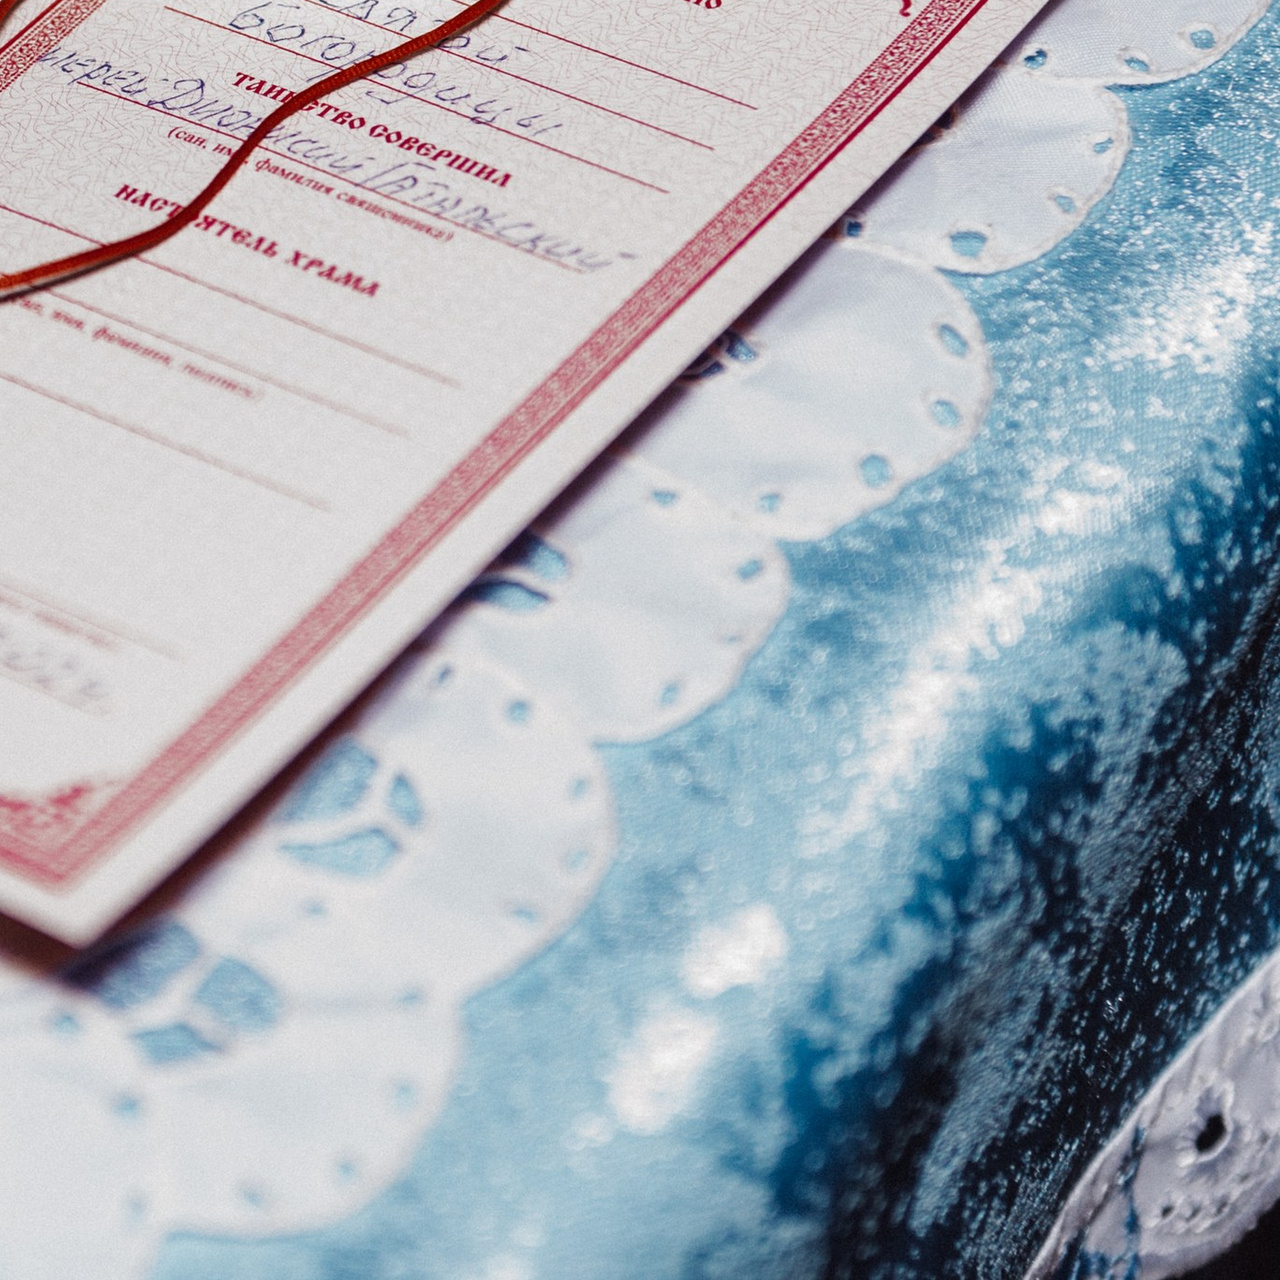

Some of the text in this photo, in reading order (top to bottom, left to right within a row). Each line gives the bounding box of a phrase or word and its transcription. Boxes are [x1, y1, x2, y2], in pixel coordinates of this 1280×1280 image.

[254, 157, 335, 196] фамилия
[369, 124, 514, 189] СОВЕРШИЛ
[113, 184, 381, 298] НАСТЯТЕЛЬ ХРАМА
